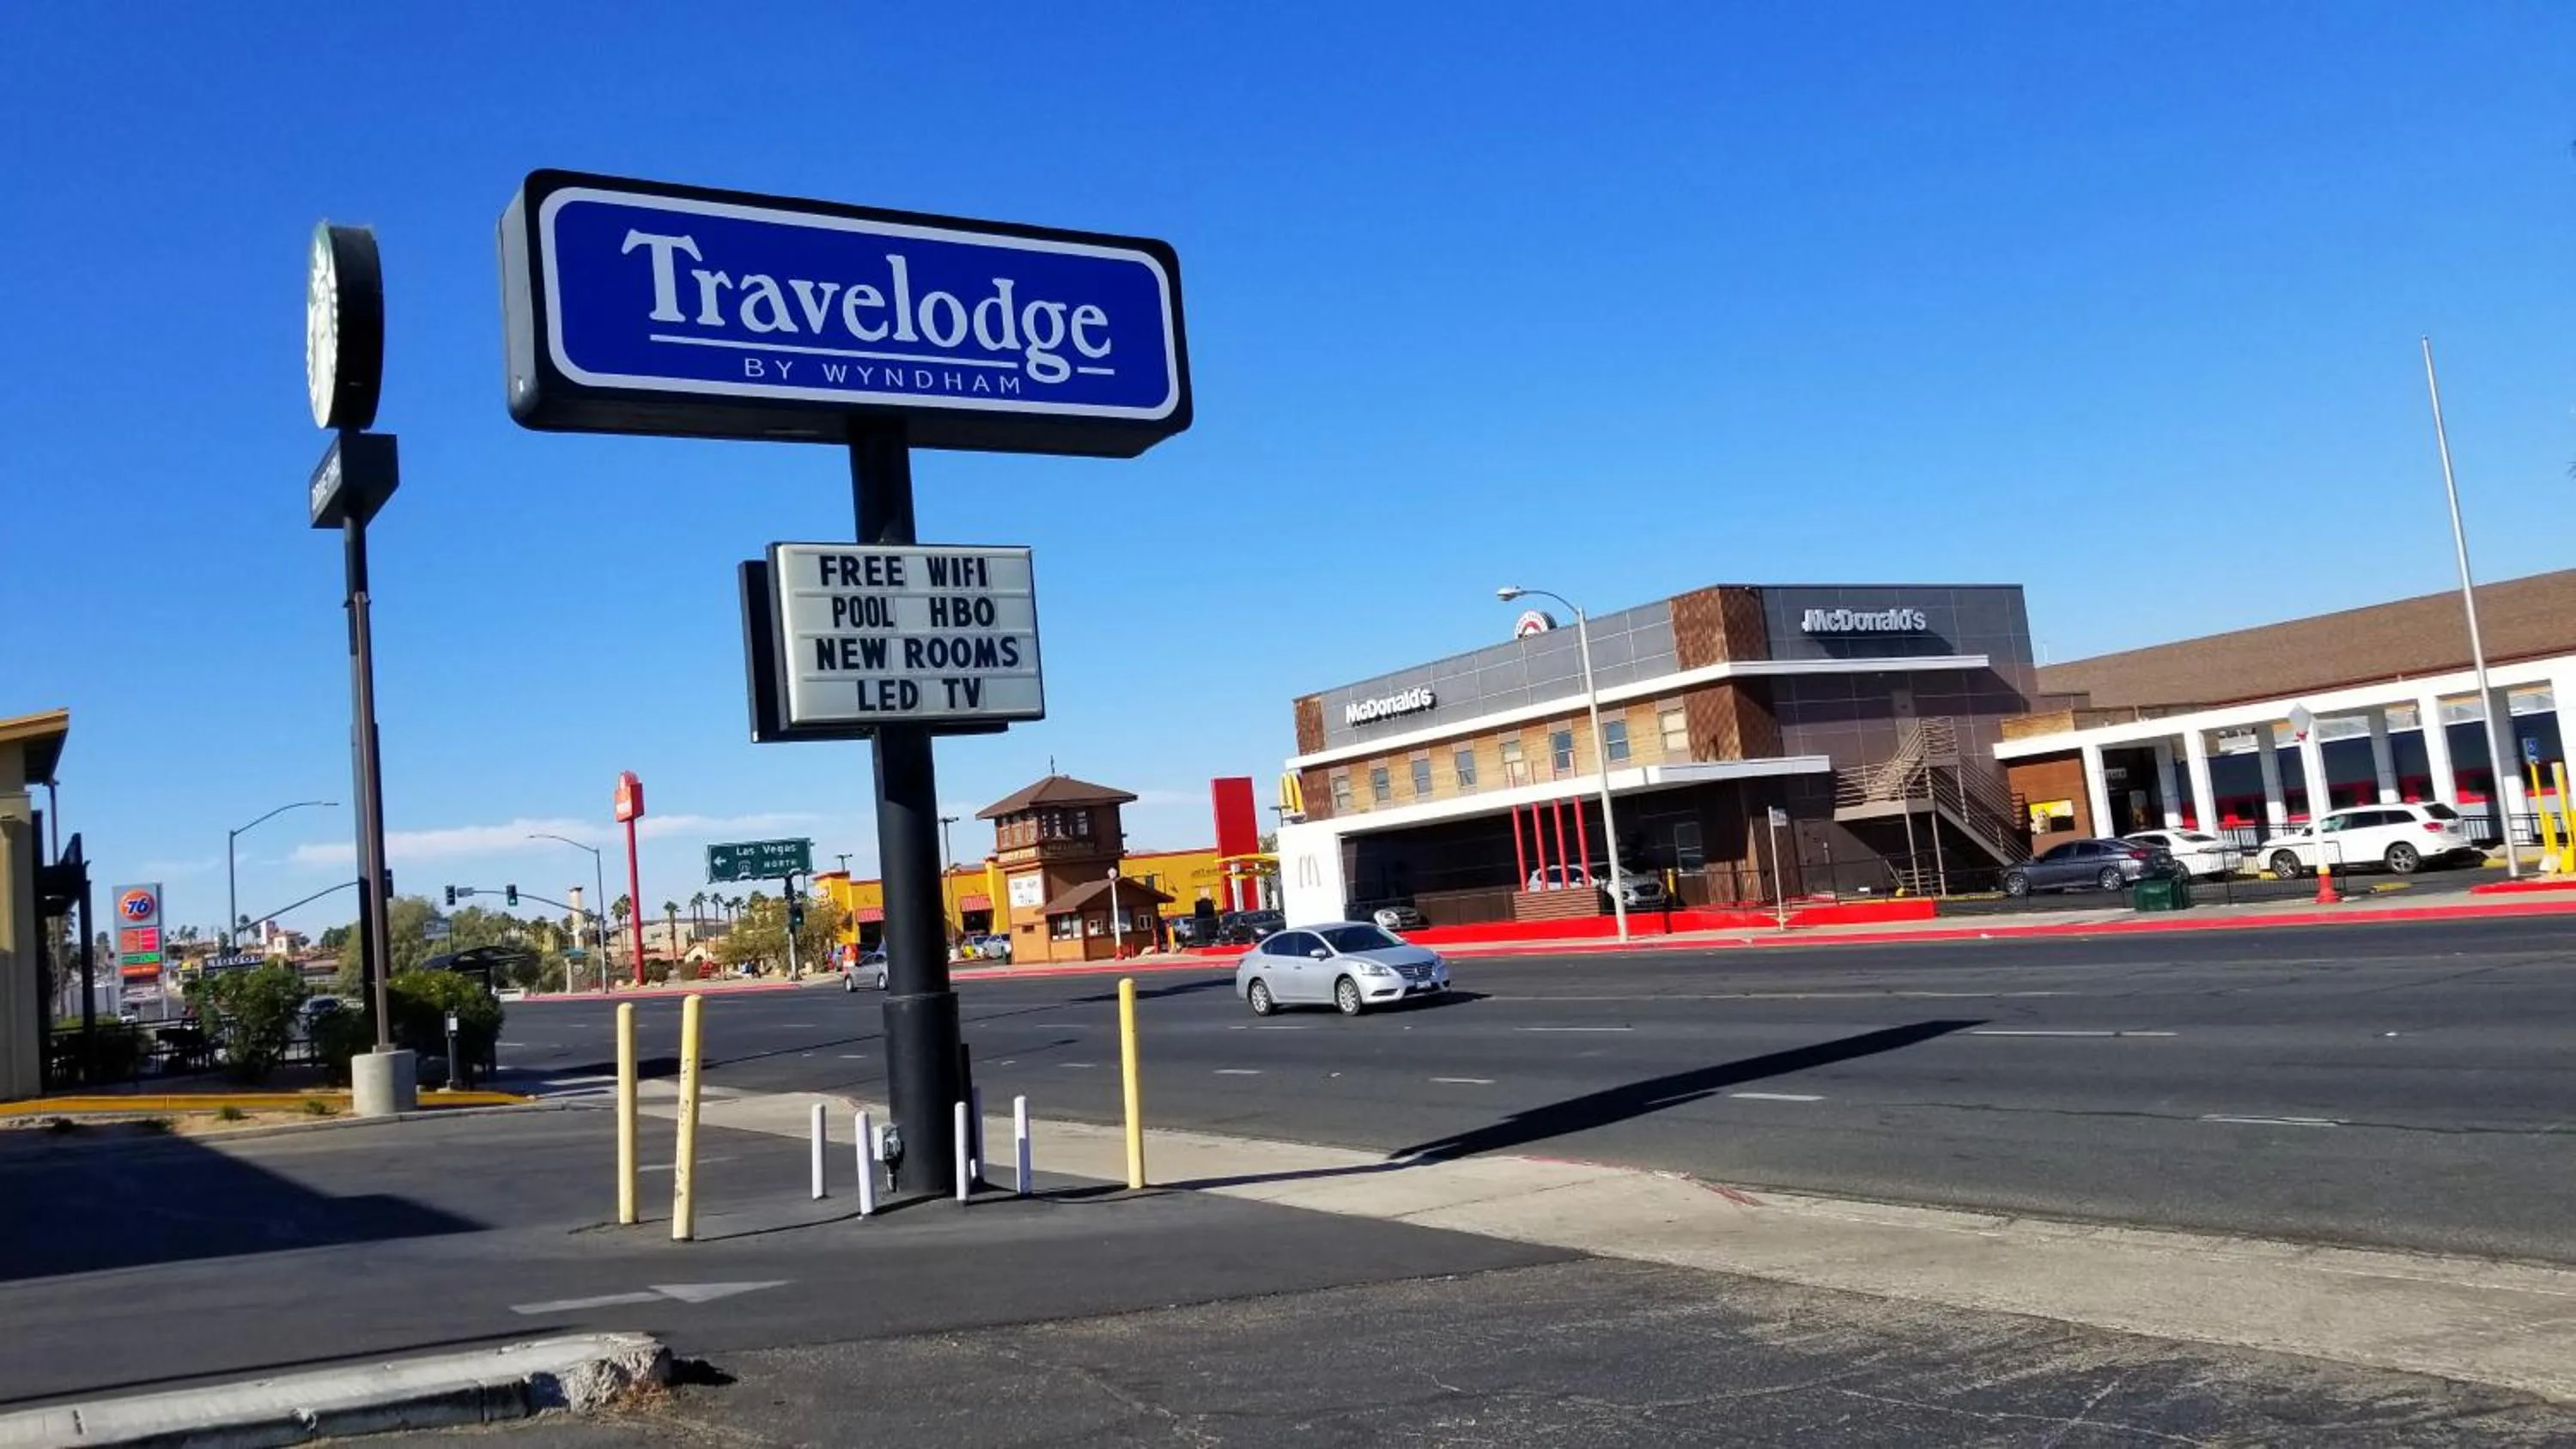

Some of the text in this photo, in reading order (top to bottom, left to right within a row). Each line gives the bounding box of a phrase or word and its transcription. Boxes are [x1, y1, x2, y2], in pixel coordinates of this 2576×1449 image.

[622, 229, 1111, 383] Travelodge
[744, 357, 1022, 395] BY WYNDHAM
[819, 555, 987, 587] FREE WIFI
[832, 596, 994, 628] POOL HBO
[1801, 609, 1926, 632] McDonald's
[816, 636, 1019, 670] NEW ROOMS
[857, 677, 981, 711] LED TV
[1346, 688, 1431, 723] McDonald's
[736, 844, 797, 855] Las Vegas
[763, 858, 798, 869] NORTH
[126, 898, 149, 915] 76
